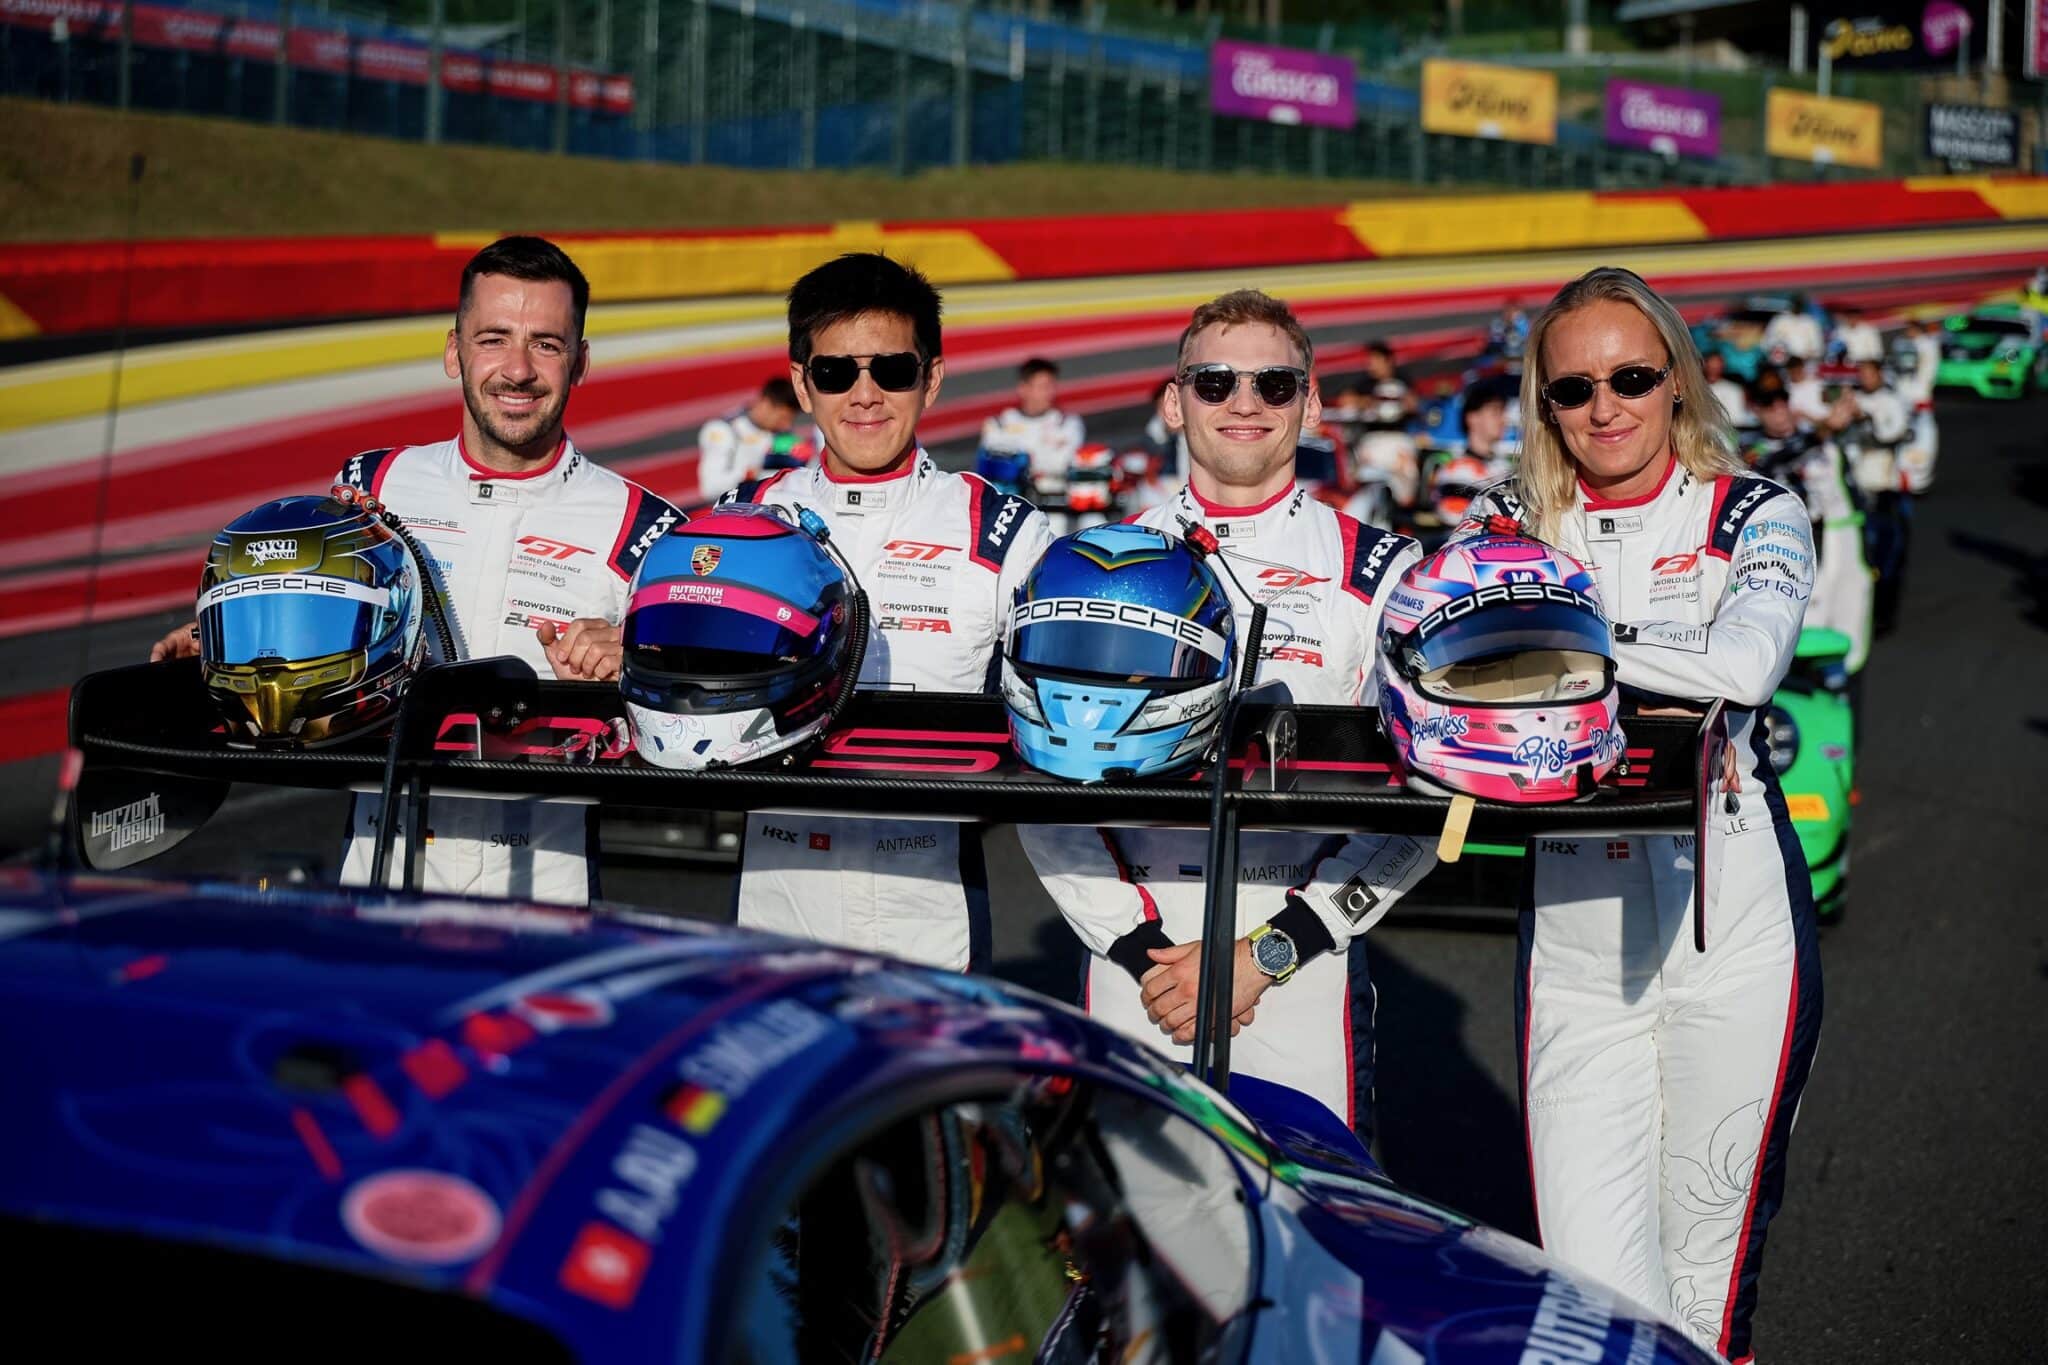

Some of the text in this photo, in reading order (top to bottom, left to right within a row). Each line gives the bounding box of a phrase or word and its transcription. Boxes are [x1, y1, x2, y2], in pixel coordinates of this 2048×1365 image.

[1722, 483, 1772, 534] HRX
[988, 497, 1023, 547] HRX
[630, 508, 678, 558] HRX
[246, 540, 297, 554] seven
[264, 551, 296, 559] seven
[885, 559, 952, 572] WORLD CHALLENGE
[1361, 533, 1400, 580] HRX
[543, 560, 582, 574] CHALLENGE
[1736, 561, 1768, 579] IRON
[877, 572, 909, 581] powered
[1654, 576, 1681, 587] WORLD
[210, 577, 347, 600] PORSCHE
[669, 584, 724, 597] RUTRONIK
[668, 593, 722, 605] RACING
[511, 599, 577, 618] CROWDSTRIKE
[882, 602, 950, 615] CROWDSTRIKE
[1014, 600, 1205, 646] PORSCHE
[1261, 633, 1322, 647] ROWDSTRIKE
[1514, 735, 1572, 784] Rise
[91, 792, 160, 838] berzerk
[110, 812, 165, 853] design
[490, 832, 529, 848] SVEN
[762, 825, 937, 853] HRX ANTARES
[1541, 840, 1580, 856] HRX
[1242, 864, 1304, 882] MARTIN
